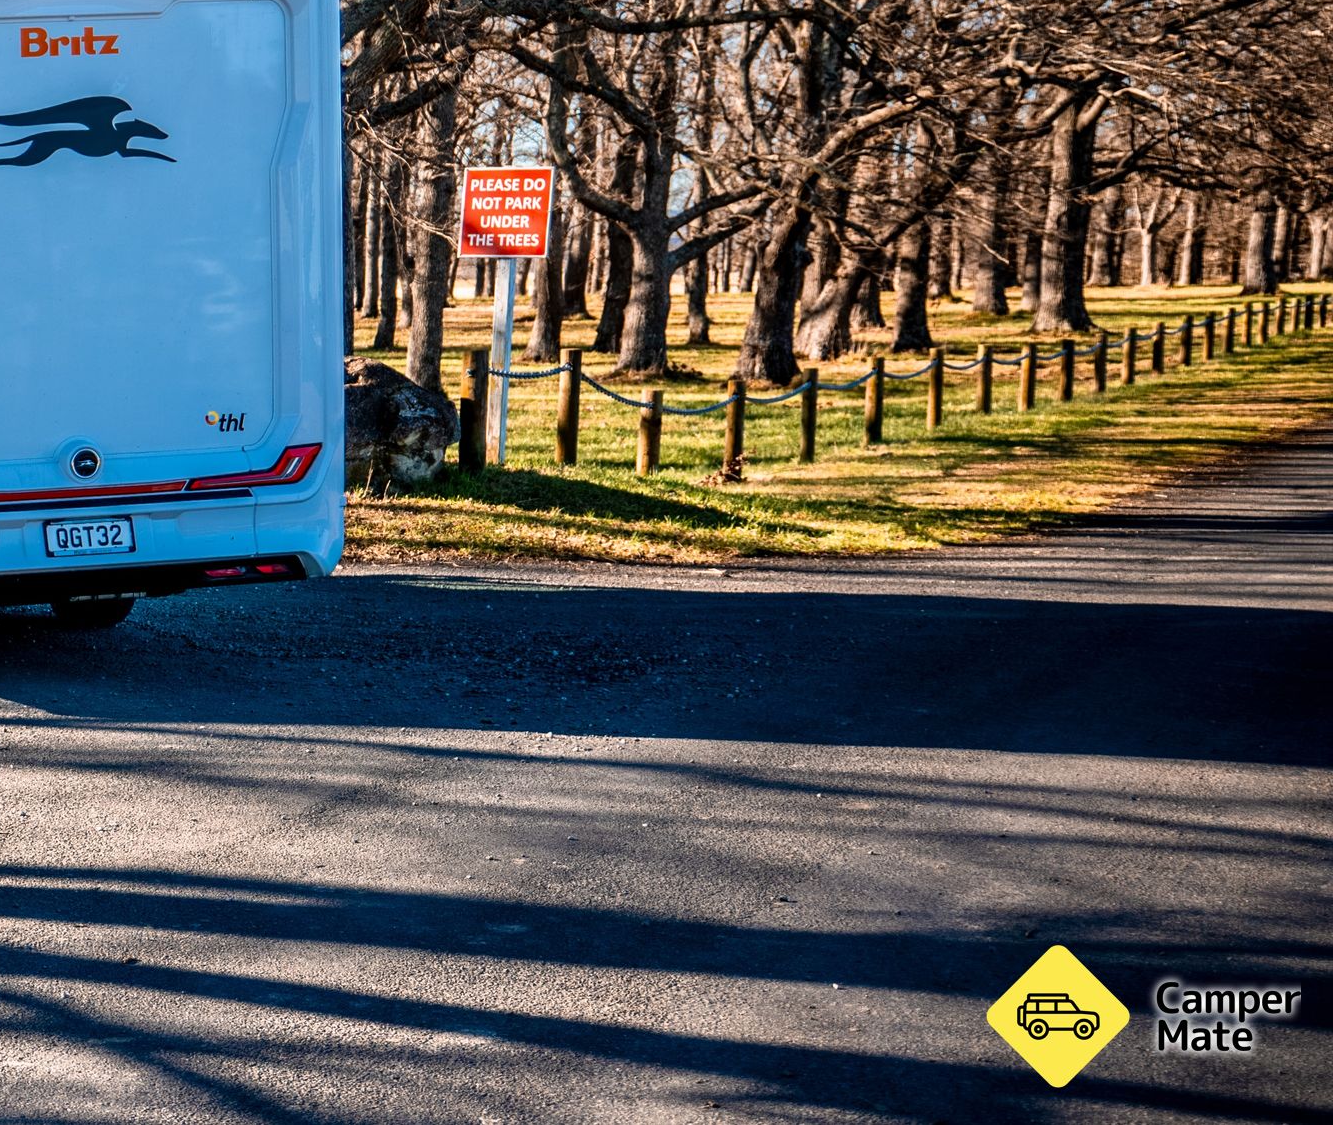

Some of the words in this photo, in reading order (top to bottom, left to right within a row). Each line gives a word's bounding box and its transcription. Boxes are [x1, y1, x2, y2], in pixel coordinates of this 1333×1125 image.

[20, 26, 119, 58] Britz
[470, 178, 520, 191] PLEASE
[523, 178, 546, 191] DO
[471, 197, 502, 210] NOT
[504, 197, 542, 210] PARK
[480, 215, 530, 228] UNDER
[468, 234, 494, 246] THE
[497, 233, 539, 247] TREES
[219, 413, 245, 432] thl
[56, 525, 123, 549] QGT32
